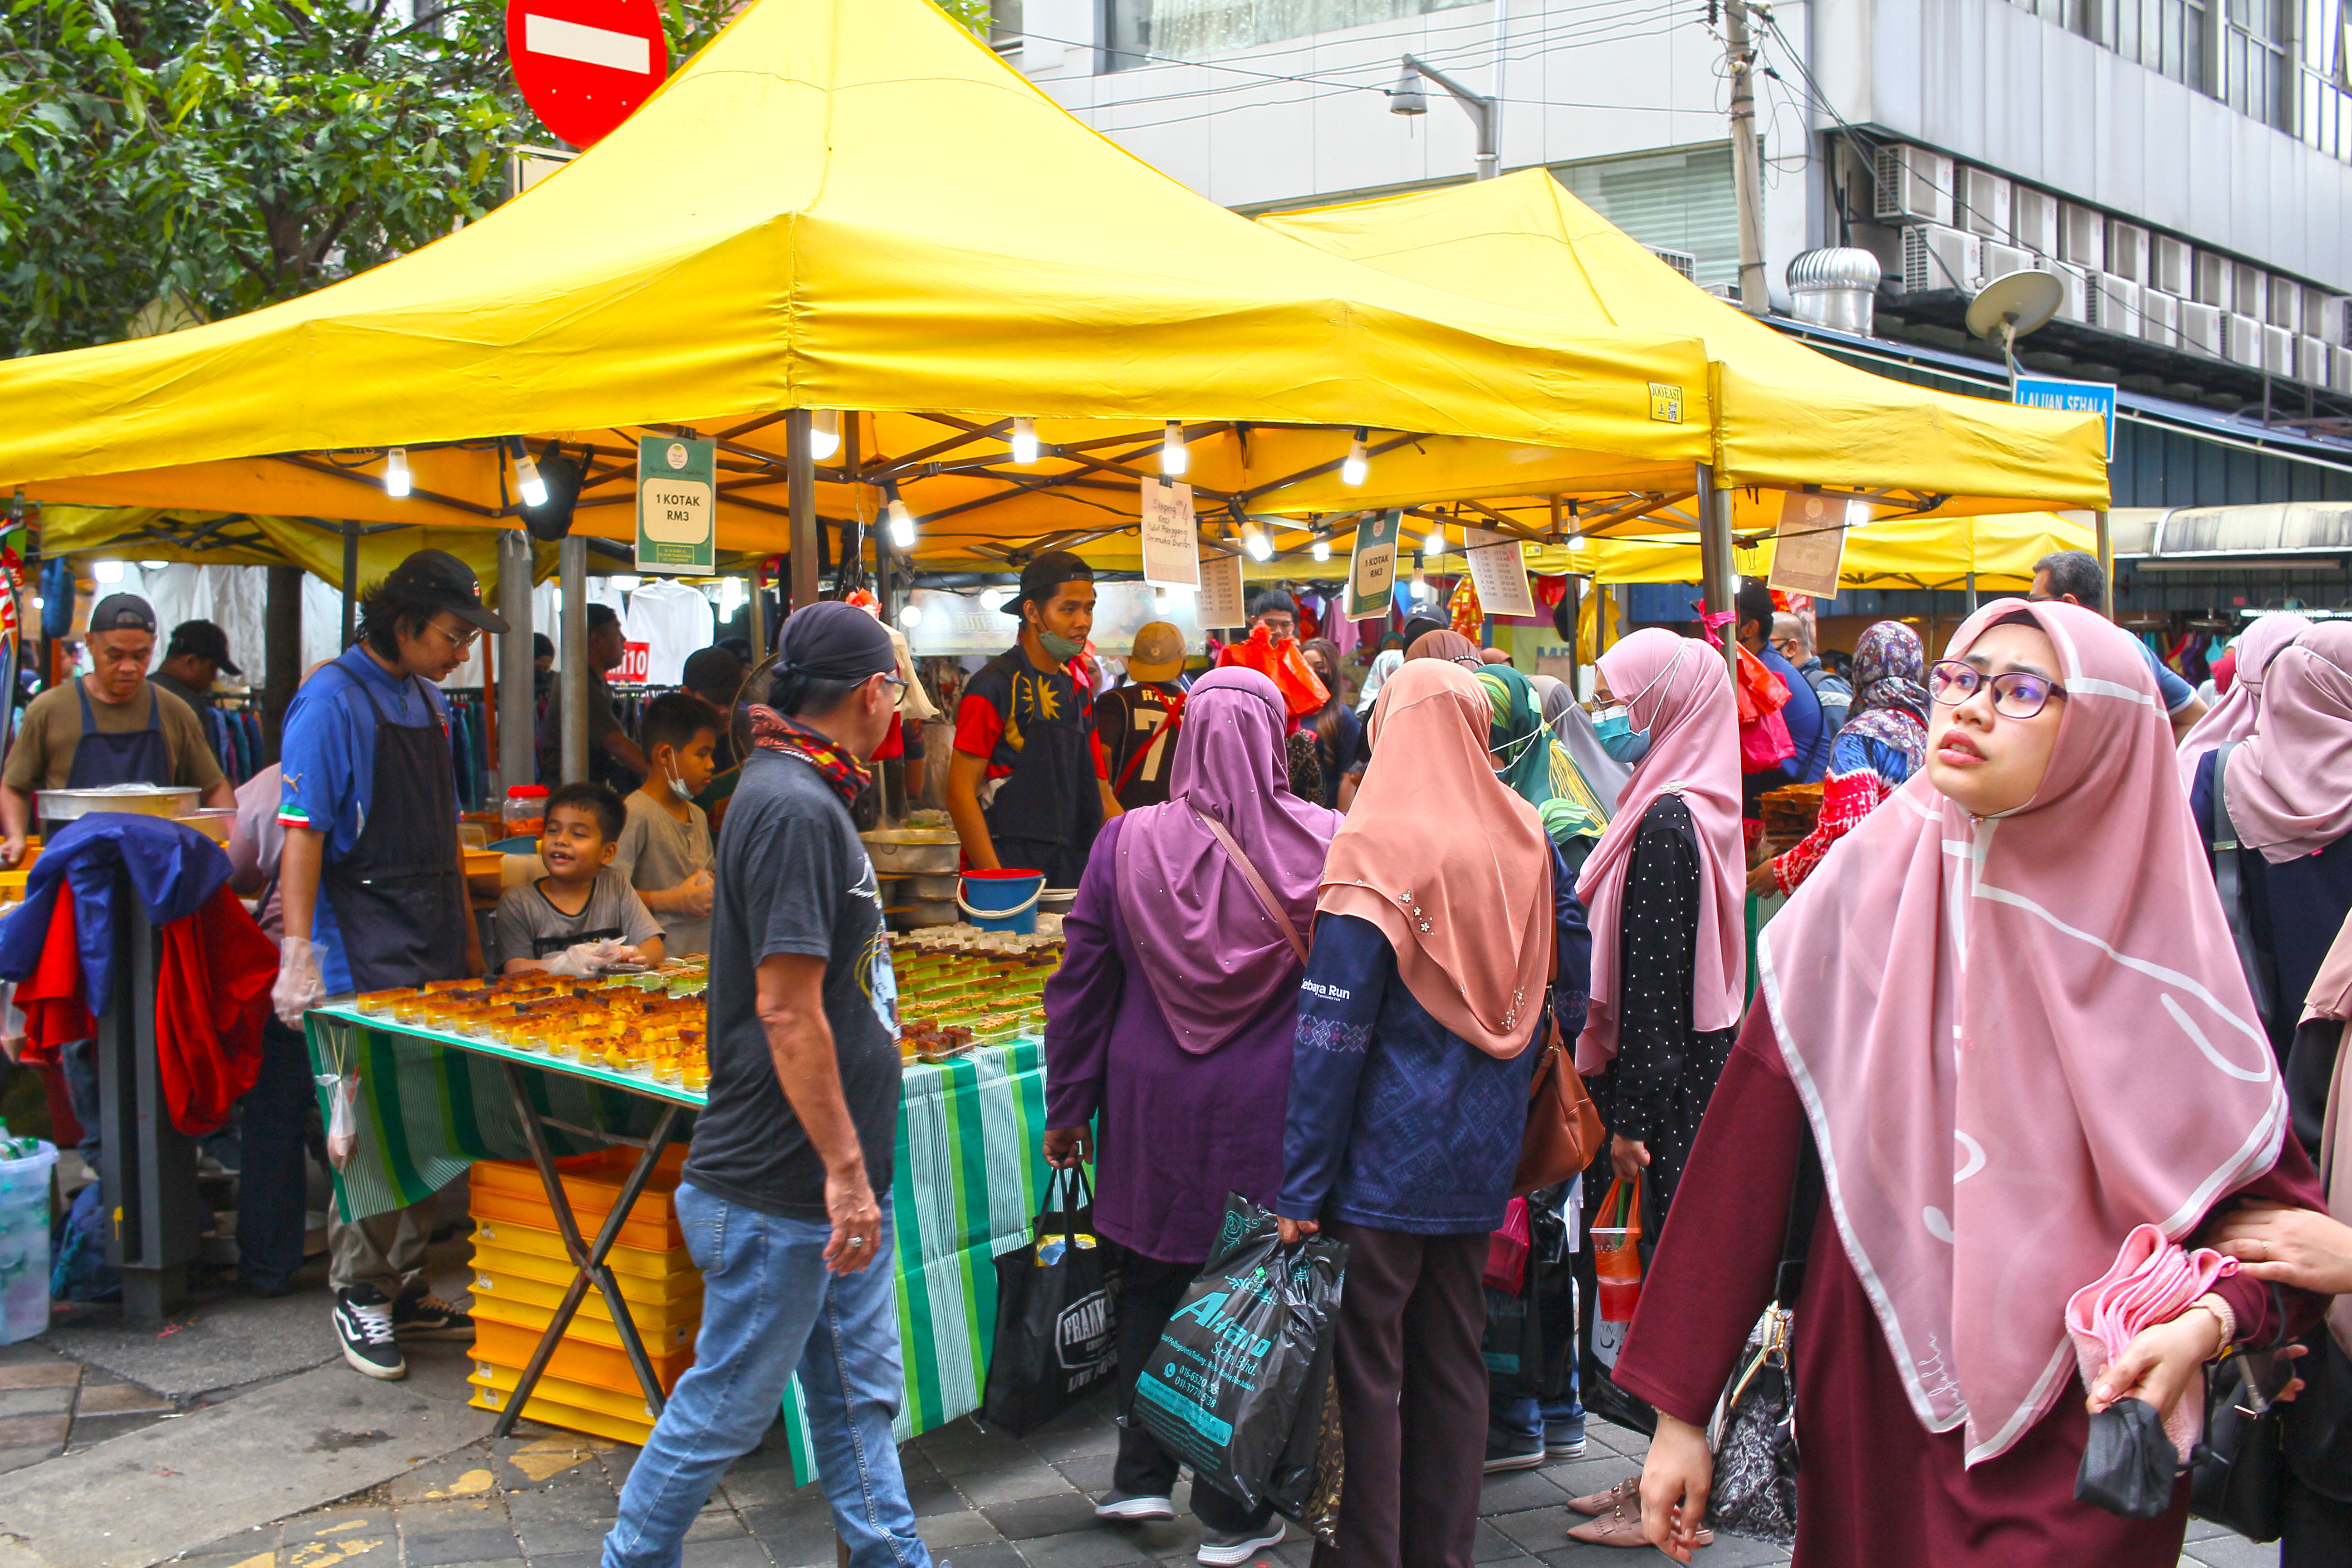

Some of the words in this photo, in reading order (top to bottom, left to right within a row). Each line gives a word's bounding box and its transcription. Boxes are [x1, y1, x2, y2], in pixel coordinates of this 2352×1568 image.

[657, 493, 660, 504] 1
[664, 494, 700, 507] KOTAK
[667, 510, 689, 521] RM3
[1369, 554, 1389, 566] KOTAK
[1370, 568, 1382, 578] RM3
[1135, 708, 1183, 781] 7
[1328, 984, 1350, 999] Run
[1170, 1291, 1271, 1357] Alfaro
[1211, 1341, 1235, 1365] Sdn.
[1235, 1355, 1259, 1376] Bhd.
